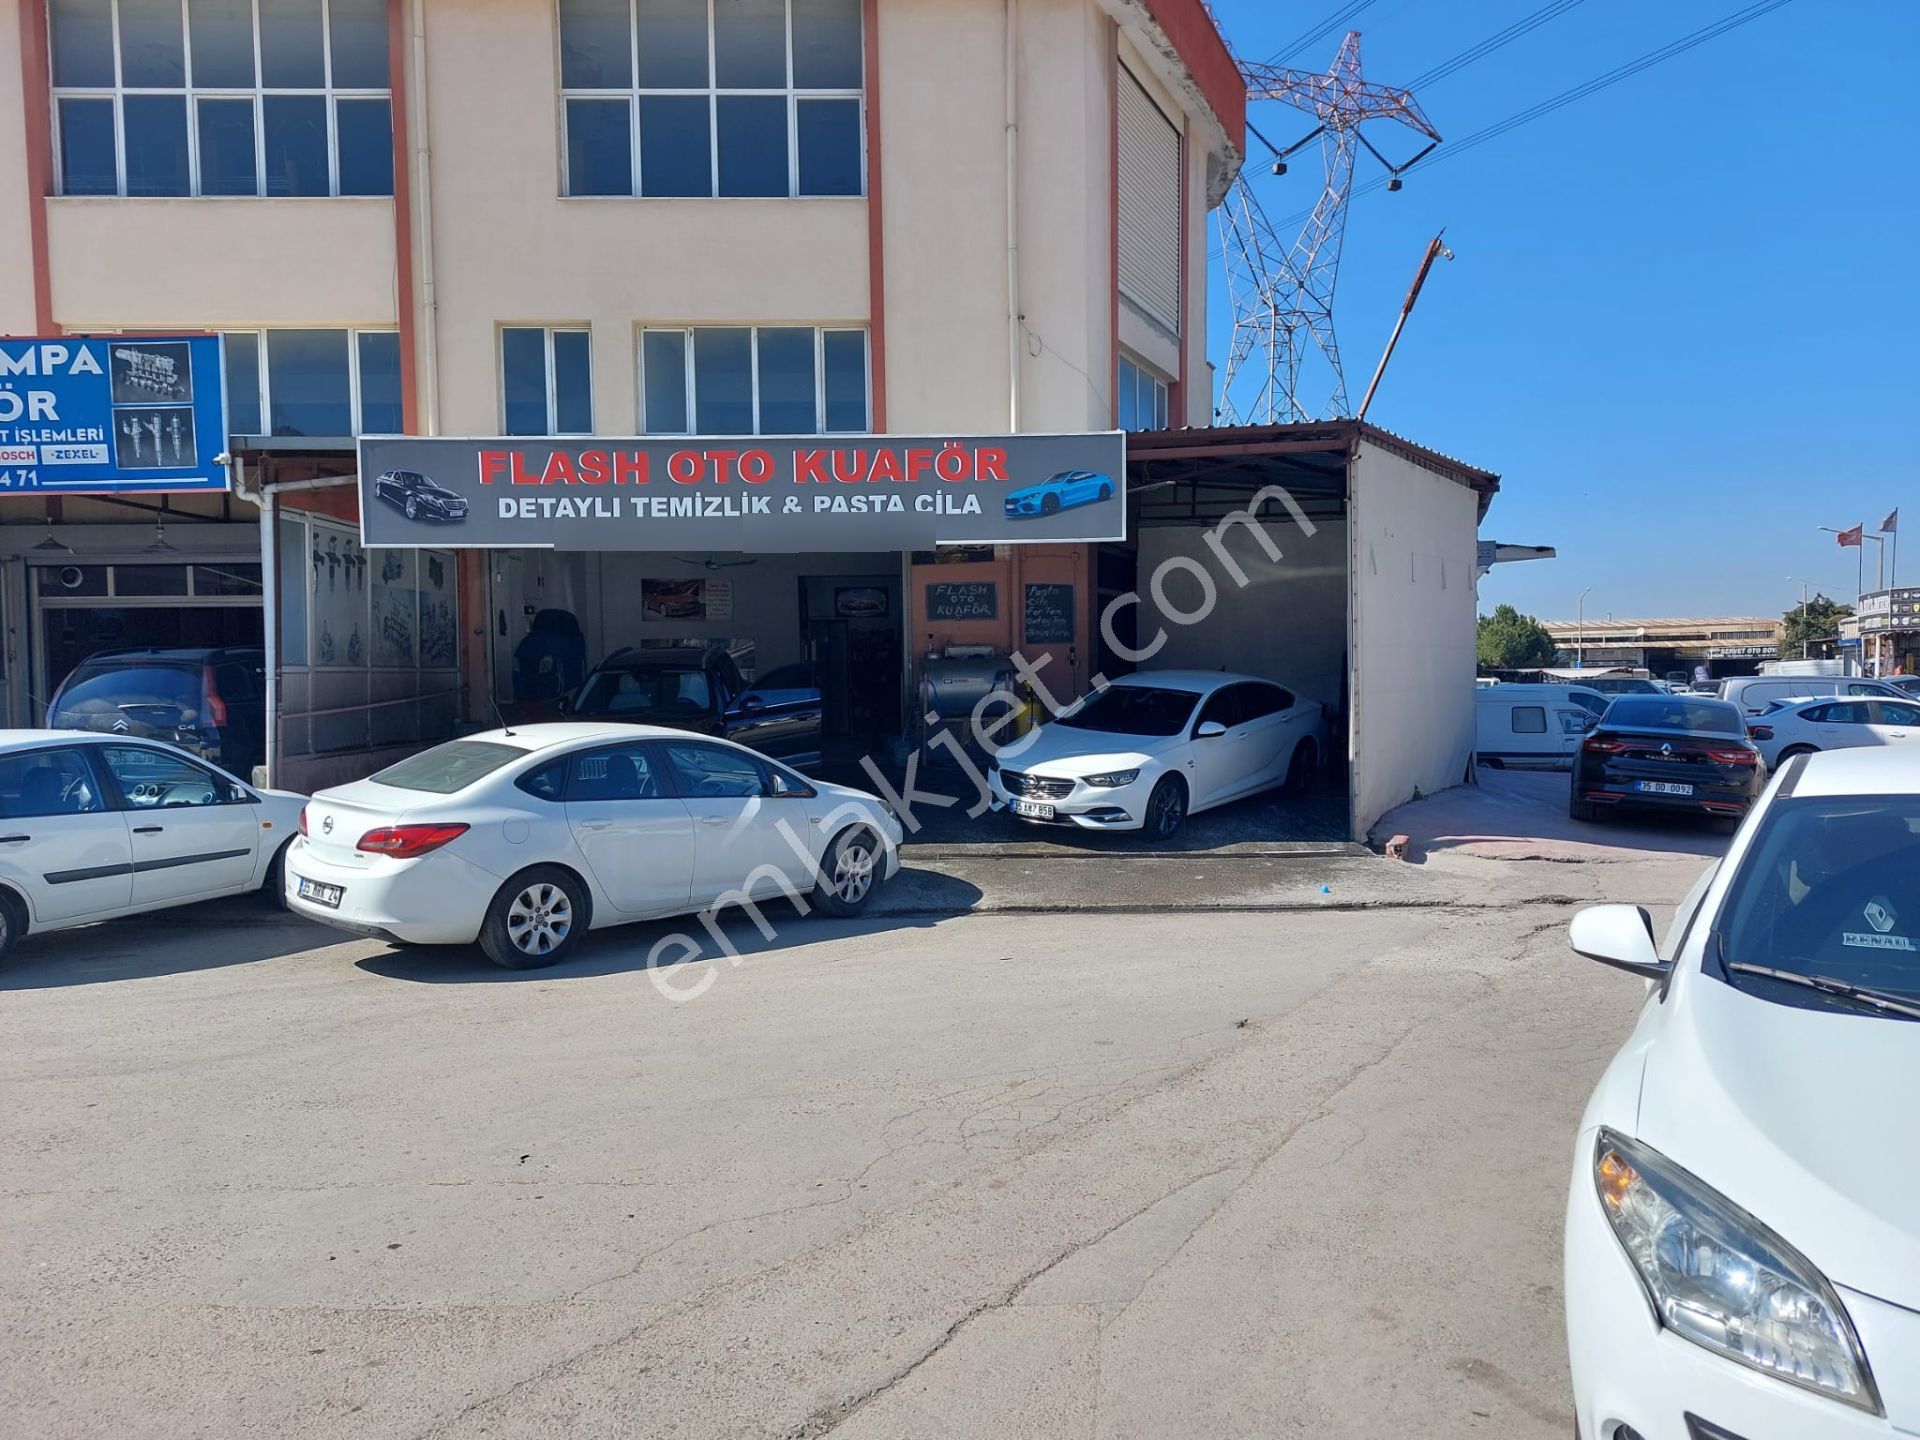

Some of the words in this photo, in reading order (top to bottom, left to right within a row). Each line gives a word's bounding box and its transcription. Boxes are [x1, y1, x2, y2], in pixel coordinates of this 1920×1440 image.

[0, 344, 104, 376] MPA
[15, 425, 104, 445] İŞLEMLERİ
[0, 451, 36, 461] OSCH
[55, 449, 97, 460] ZEXEL
[478, 449, 649, 486] FLASH
[667, 449, 775, 485] OTO
[792, 441, 1010, 485] KUAFÖR
[498, 496, 621, 519] DETAYLI
[630, 491, 772, 518] TEMİZLİK
[783, 496, 803, 514] &
[814, 494, 905, 513] PASTA
[914, 489, 982, 514] CİLA
[936, 585, 988, 597] FLASH
[951, 595, 975, 603] OTO
[936, 602, 993, 616] KUAFÖR
[1641, 781, 1652, 791] 35
[1670, 784, 1692, 794] 0092
